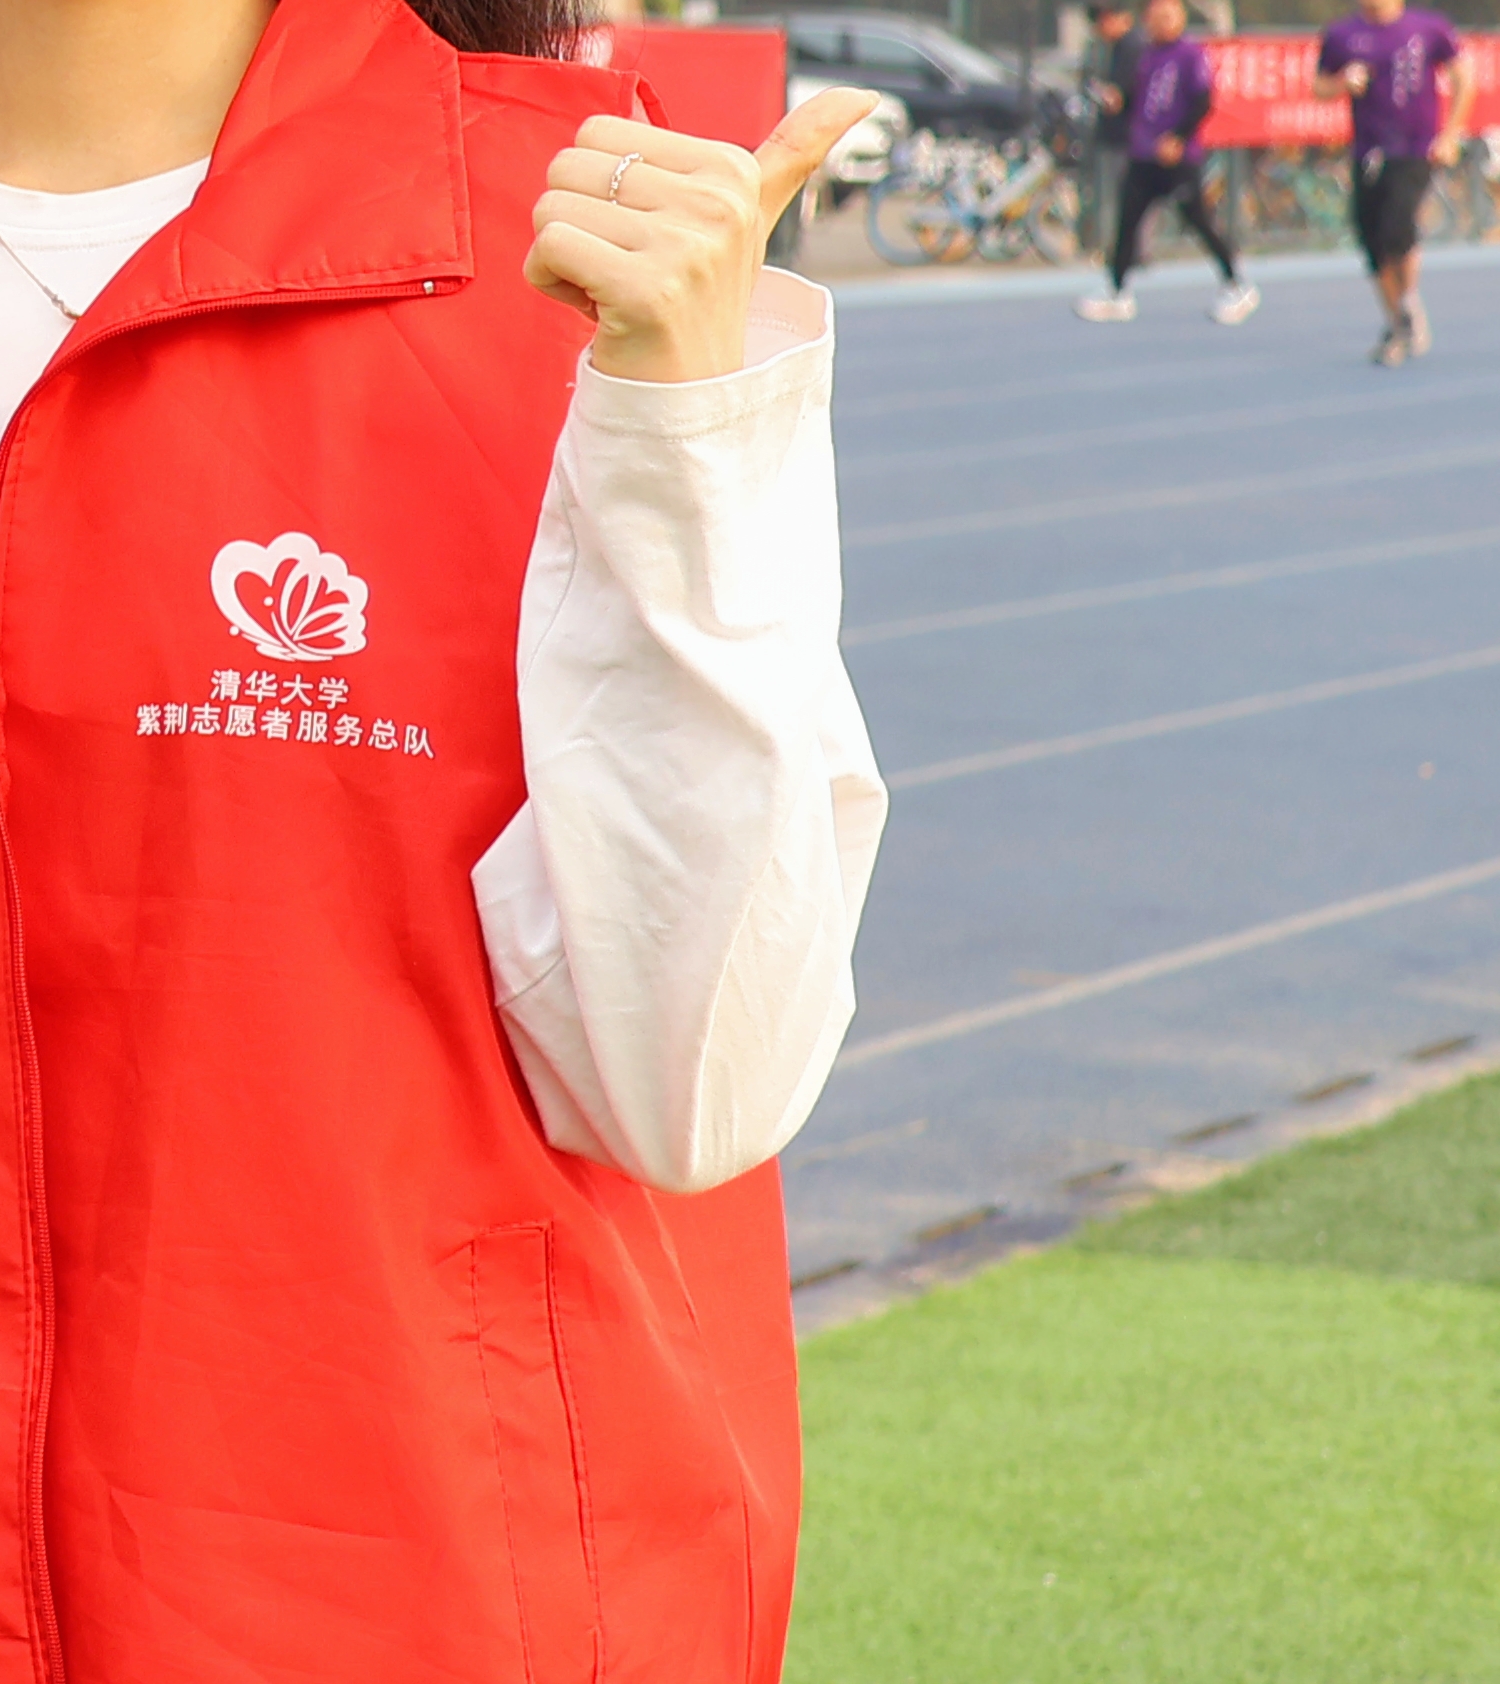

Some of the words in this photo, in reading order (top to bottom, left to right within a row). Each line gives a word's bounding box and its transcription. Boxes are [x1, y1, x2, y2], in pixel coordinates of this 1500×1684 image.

[210, 668, 349, 710] 清华大学
[136, 702, 435, 759] 紫荆志愿者服务总队
